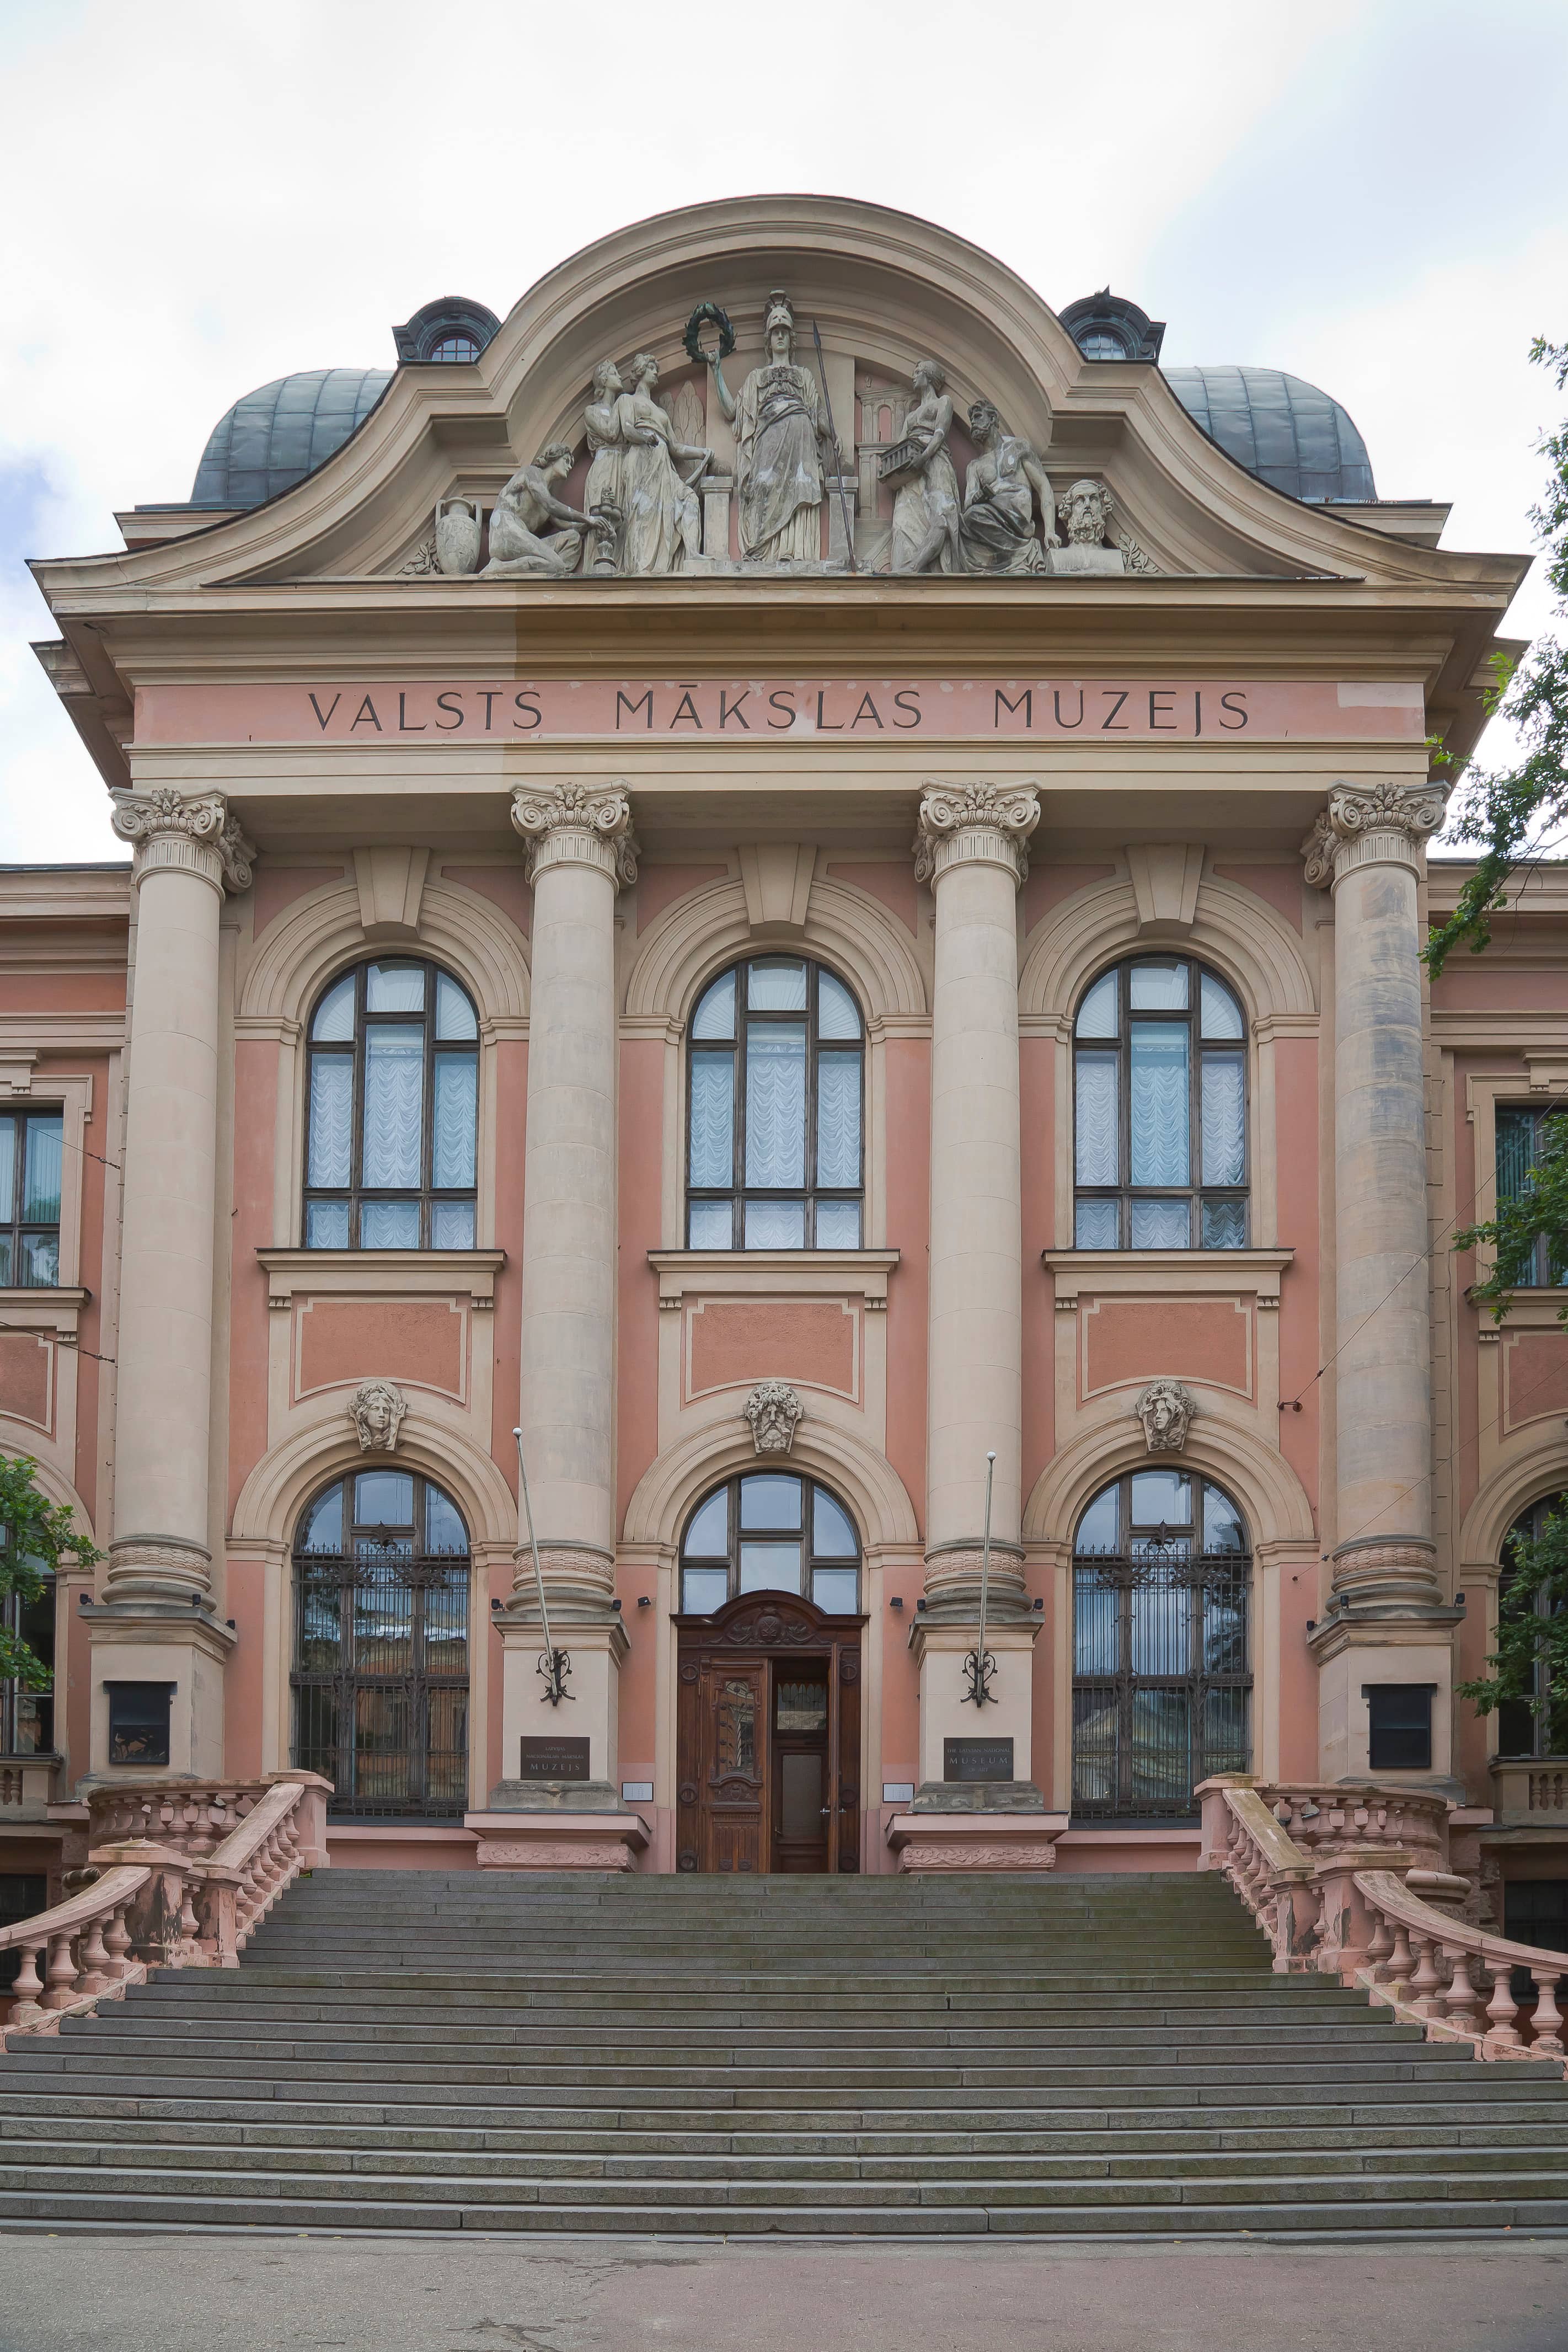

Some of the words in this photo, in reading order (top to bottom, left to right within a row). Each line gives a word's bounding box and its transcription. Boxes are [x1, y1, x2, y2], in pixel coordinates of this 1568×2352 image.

[308, 691, 542, 731] VALSTS
[616, 685, 922, 729] MĀKSLAS
[994, 689, 1248, 736] MUZEJS
[530, 1763, 580, 1772] MUZEJS
